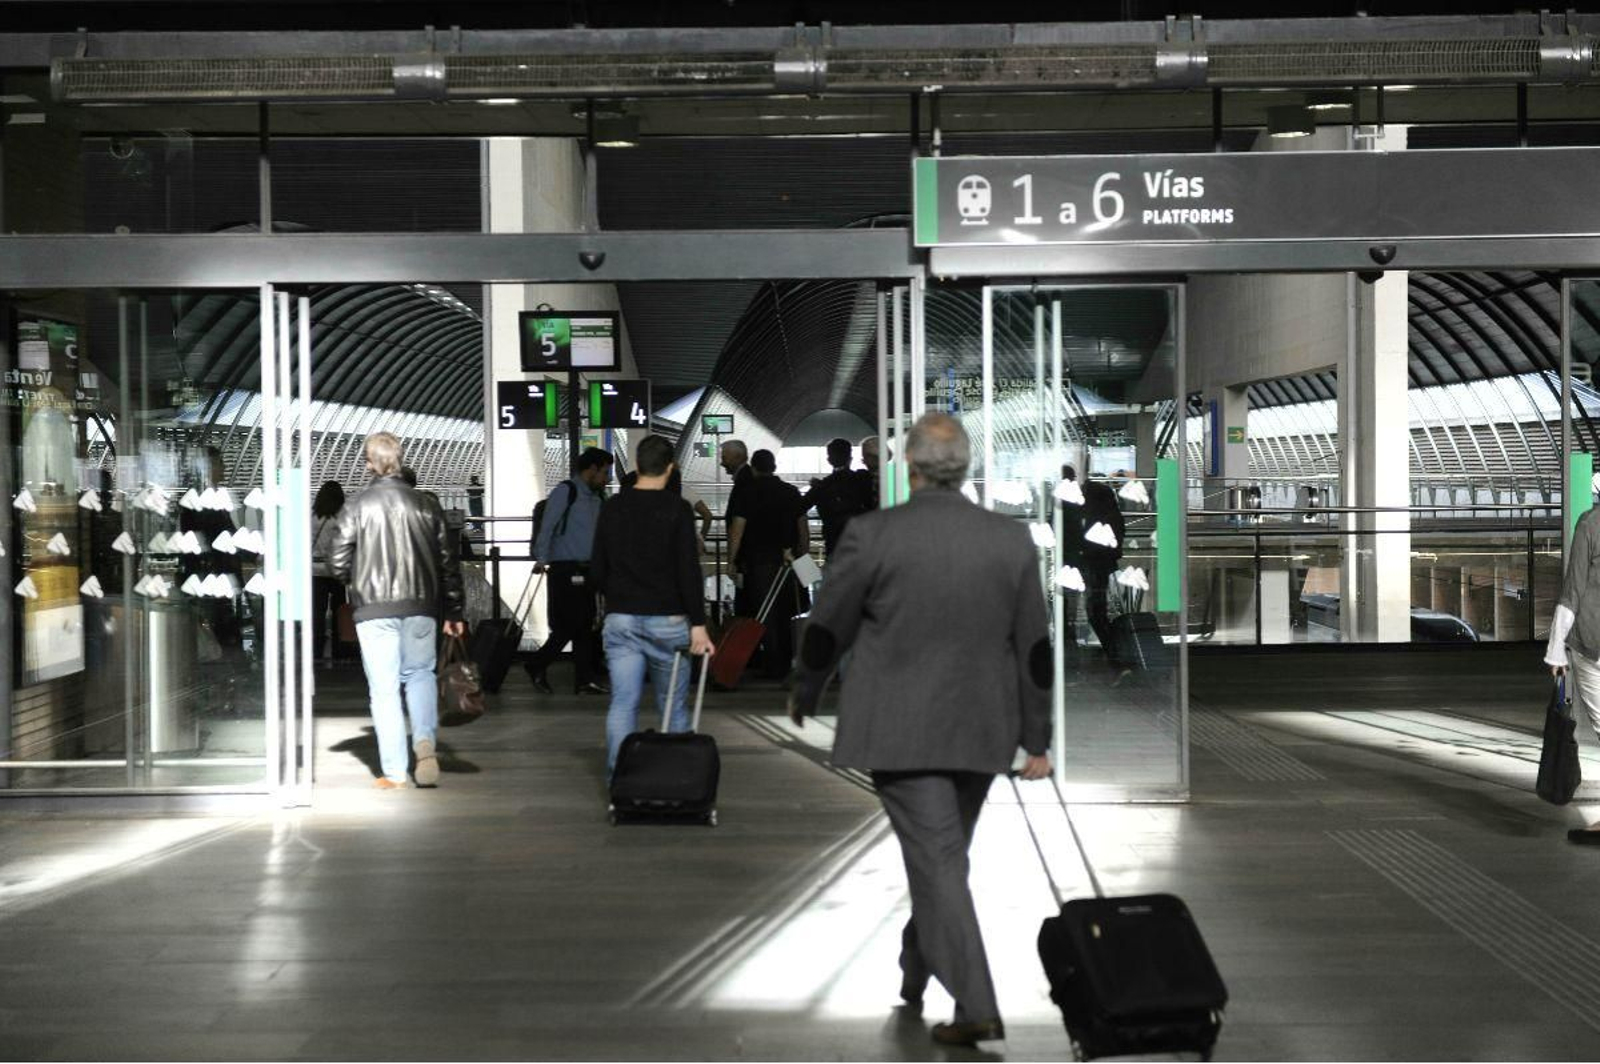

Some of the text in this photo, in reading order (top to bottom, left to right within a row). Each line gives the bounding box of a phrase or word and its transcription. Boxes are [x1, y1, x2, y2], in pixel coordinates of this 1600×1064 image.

[1143, 169, 1205, 198] Vías
[1012, 171, 1125, 225] 1 a 6
[1142, 208, 1235, 226] PLATFORMS
[541, 332, 556, 356] 5
[501, 405, 515, 427] 5
[630, 402, 646, 425] 4
